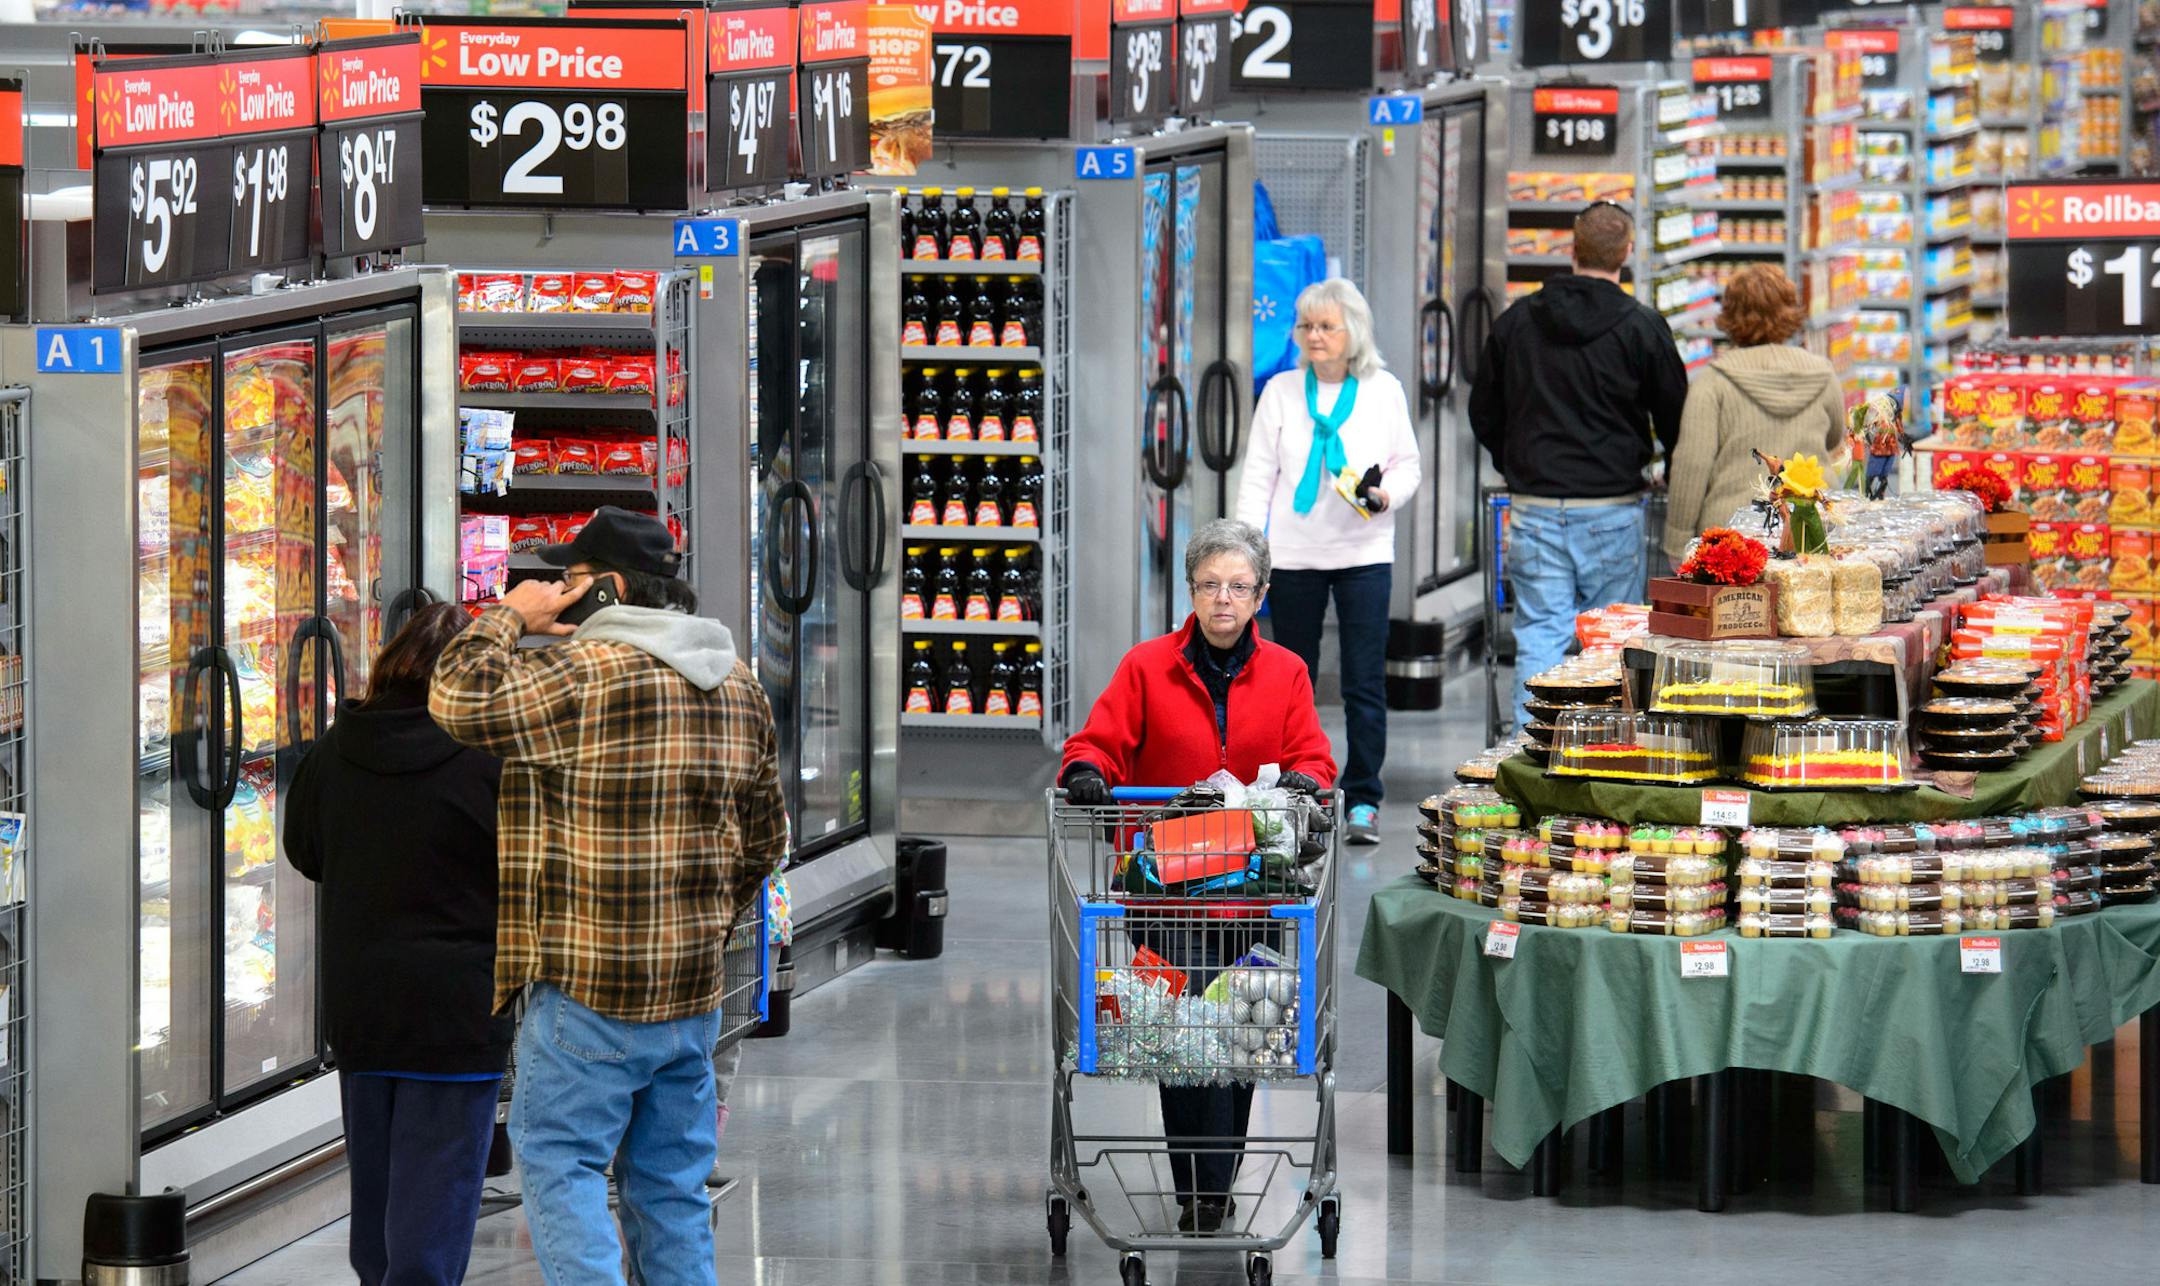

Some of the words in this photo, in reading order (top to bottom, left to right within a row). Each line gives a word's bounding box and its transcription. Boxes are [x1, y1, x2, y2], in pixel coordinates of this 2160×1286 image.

[944, 0, 1018, 26] Price
[459, 31, 520, 52] Everyday
[727, 29, 749, 61] Low
[749, 28, 775, 59] Price
[816, 23, 834, 52] Low
[834, 20, 856, 49] Price
[341, 56, 364, 77] Everyday
[459, 47, 531, 77] Low
[537, 46, 624, 79] Price
[124, 78, 151, 99] Everyday
[238, 69, 261, 86] Everyday
[342, 74, 369, 108] Low
[369, 68, 401, 104] Price
[125, 97, 157, 133] Low
[158, 91, 196, 130] Price
[239, 86, 265, 123] Low
[265, 82, 296, 119] Price
[1373, 104, 1393, 121] A
[1400, 102, 1415, 120] 7
[1081, 154, 1100, 175] A
[1112, 154, 1127, 175] 5
[677, 225, 701, 252] A
[713, 225, 730, 251] 3
[45, 334, 72, 367] A
[90, 336, 104, 366] 1
[1717, 592, 1763, 606] AMERICAN
